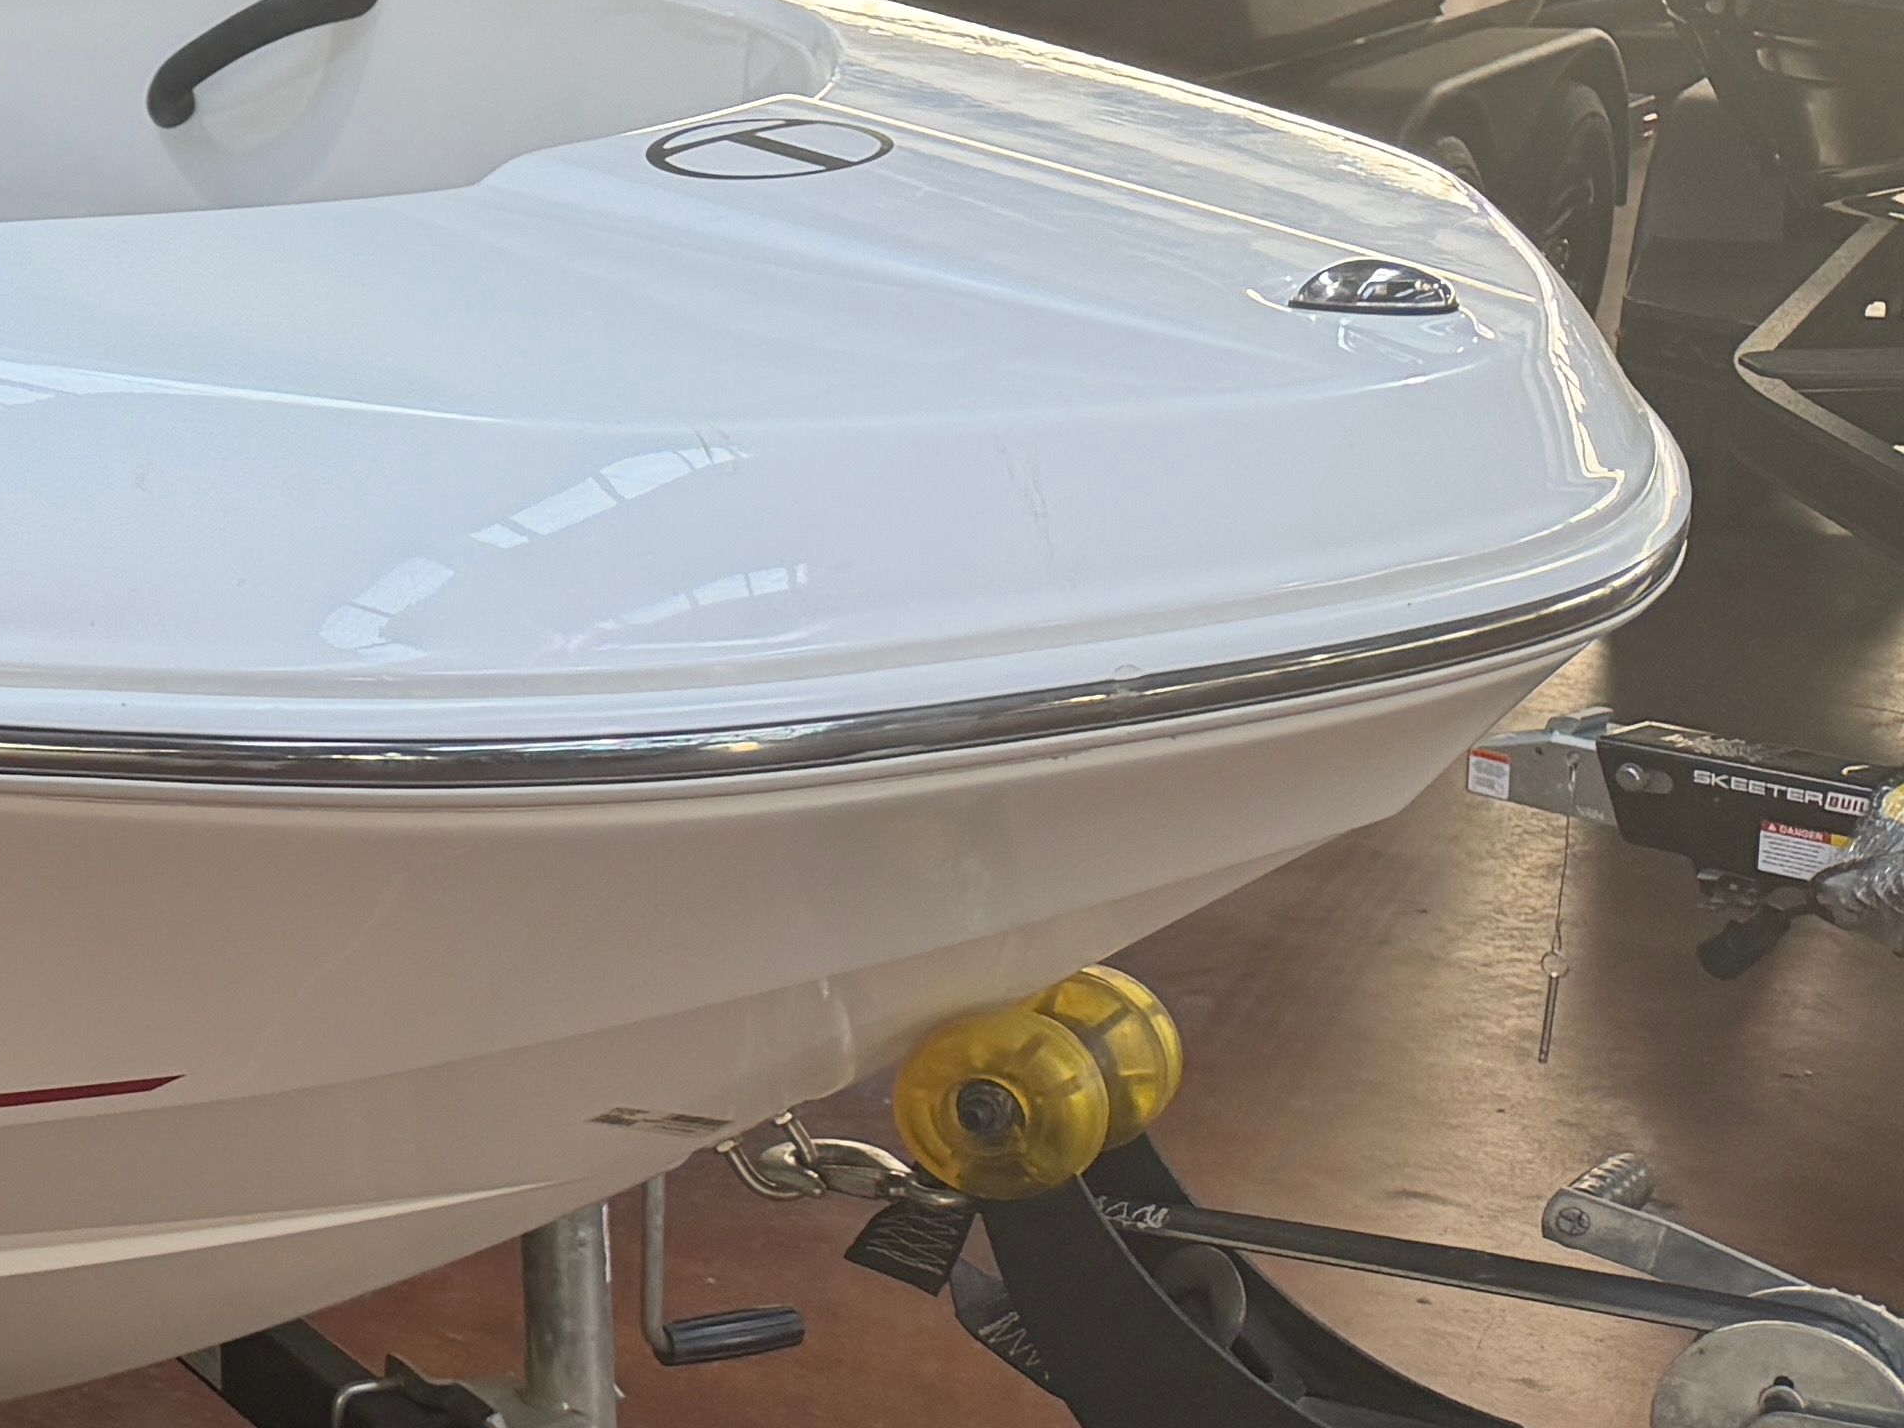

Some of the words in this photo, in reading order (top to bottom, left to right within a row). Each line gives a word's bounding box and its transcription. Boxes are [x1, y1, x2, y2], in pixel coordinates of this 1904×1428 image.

[1692, 769, 1824, 806] SKEETER
[1828, 795, 1870, 815] BUIL
[1778, 824, 1824, 841] DANGER
